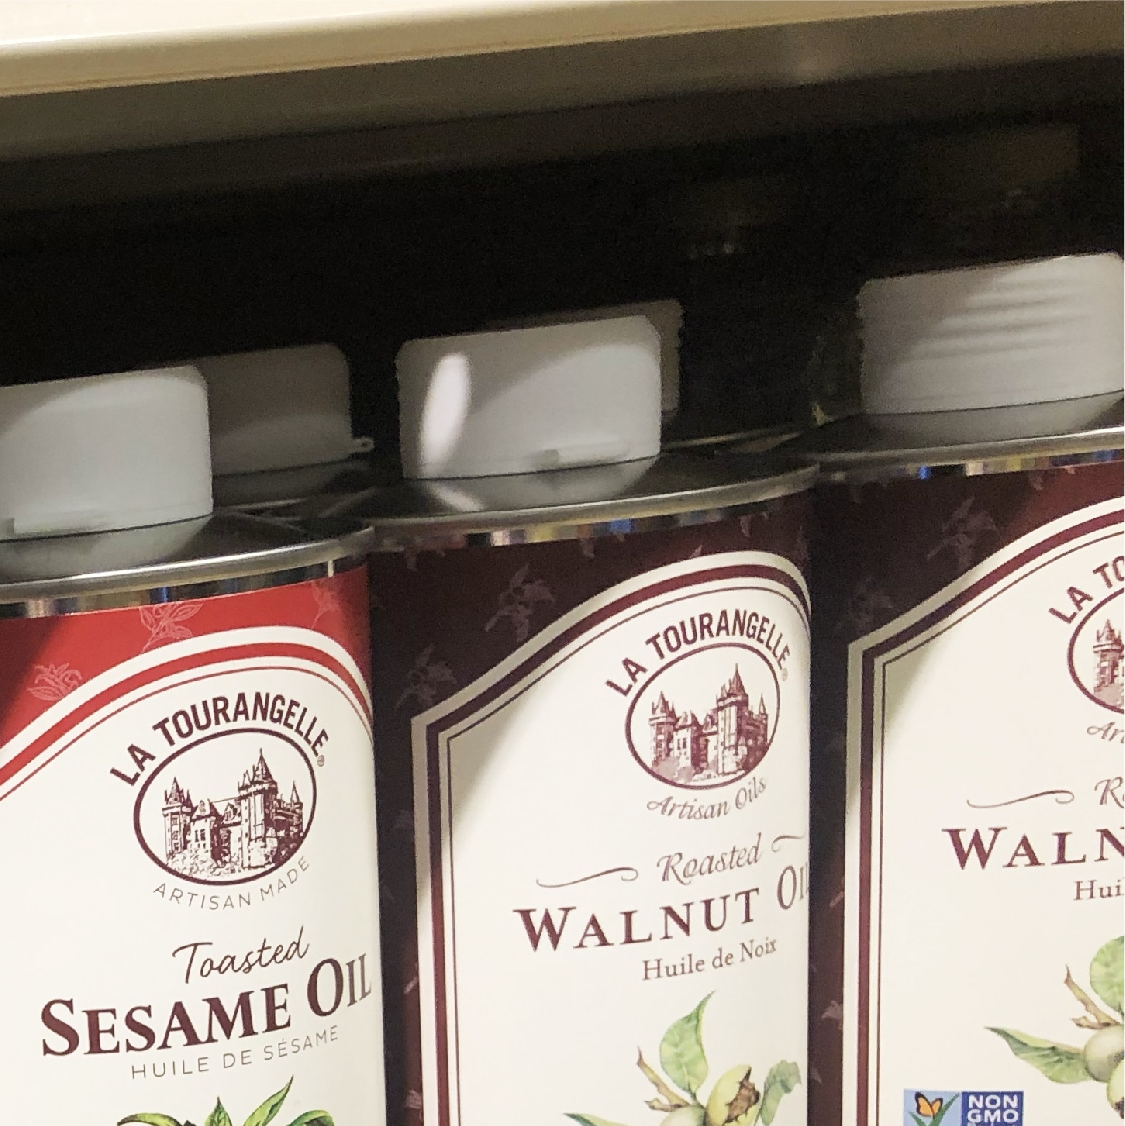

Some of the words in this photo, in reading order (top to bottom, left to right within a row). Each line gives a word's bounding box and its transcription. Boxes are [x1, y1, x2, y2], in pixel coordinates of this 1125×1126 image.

[1048, 586, 1094, 625] LA
[605, 657, 647, 697] LA
[645, 608, 791, 671] TOURANGELLE
[109, 743, 157, 787] LA
[152, 692, 330, 758] TOURANGELLE
[646, 795, 730, 821] Artisan
[734, 776, 767, 811] Oils
[152, 881, 252, 911] ARTISAN
[259, 855, 310, 900] MADE
[656, 831, 762, 887] Roasted
[512, 887, 760, 953] WALNUT
[171, 924, 310, 985] Toasted
[641, 953, 705, 982] Huile
[711, 948, 734, 969] de
[740, 936, 778, 965] Noix
[40, 983, 292, 1058] SESAME
[306, 953, 373, 1017] OIL
[131, 1057, 210, 1080] HUILE
[223, 1050, 253, 1070] DE
[263, 1025, 339, 1063] SÉSAME
[967, 1109, 1019, 1123] GMO
[968, 1094, 1019, 1109] NON
